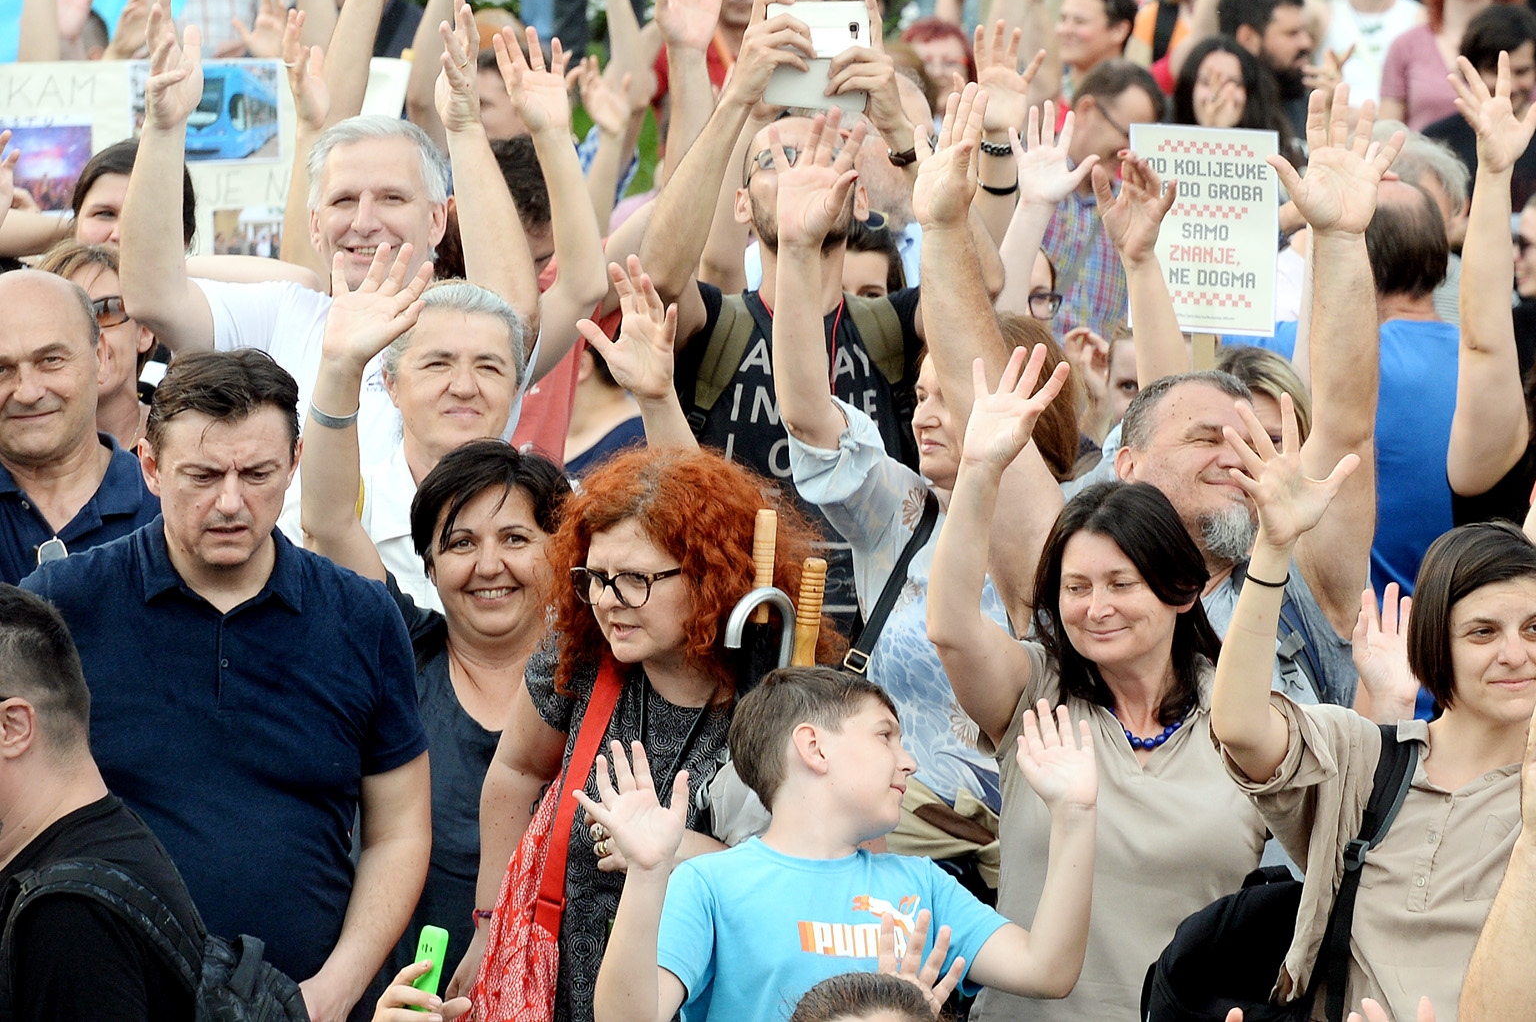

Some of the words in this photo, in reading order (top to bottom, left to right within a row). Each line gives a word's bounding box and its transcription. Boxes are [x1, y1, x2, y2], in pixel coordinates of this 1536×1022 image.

[1174, 159, 1267, 181] KOLIJEVKE
[1179, 181, 1201, 198] DO
[1208, 183, 1263, 203] GROBA
[1181, 223, 1229, 241] SAMO
[1169, 245, 1241, 266] ZNANJE,
[1169, 268, 1190, 285] NE
[1197, 270, 1256, 289] DOGMA
[739, 338, 772, 375] A
[827, 343, 870, 380] AY
[730, 383, 780, 426] IN
[814, 921, 909, 961] PUMA
